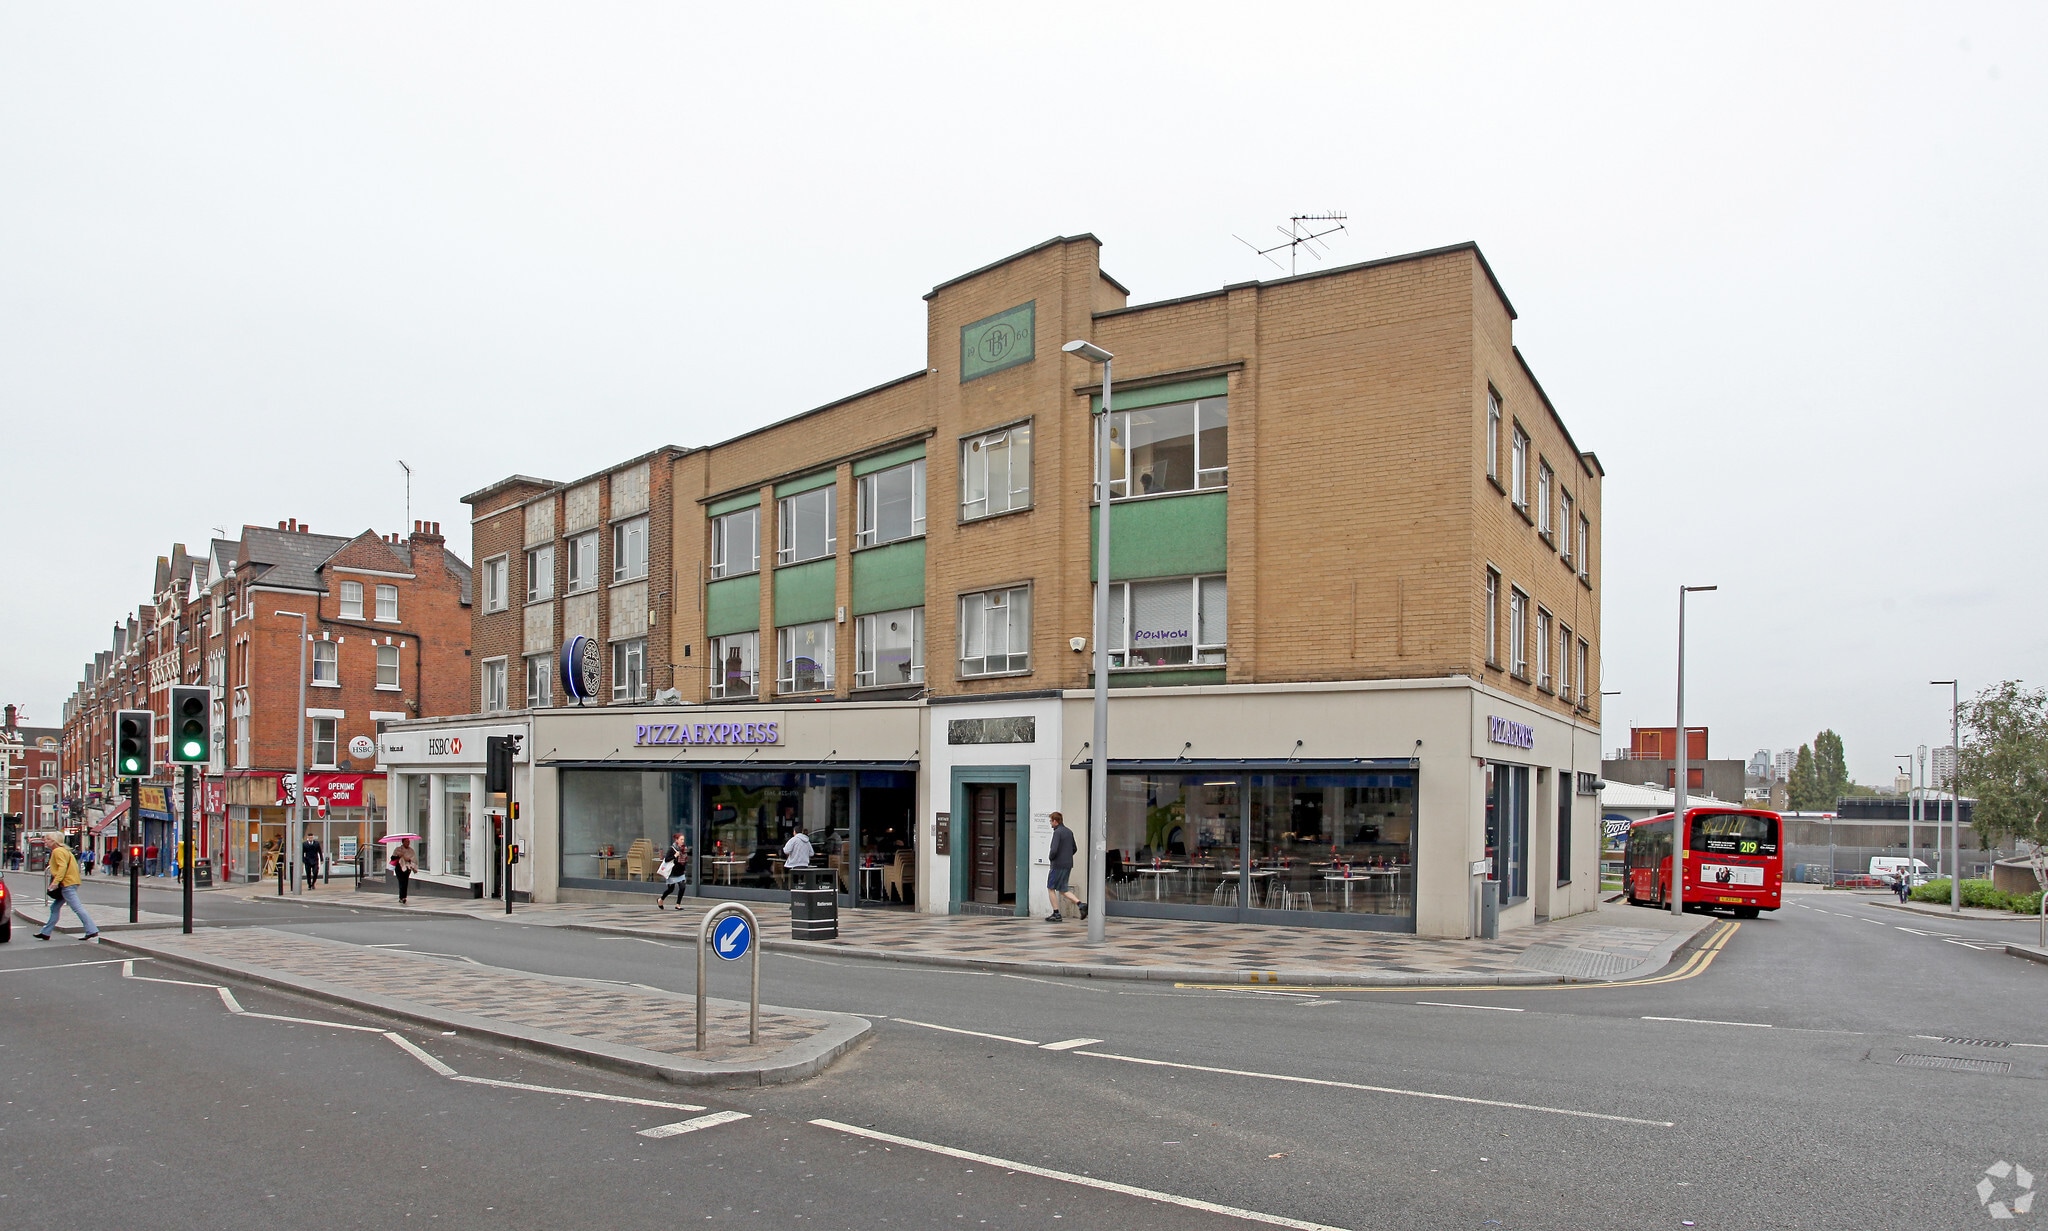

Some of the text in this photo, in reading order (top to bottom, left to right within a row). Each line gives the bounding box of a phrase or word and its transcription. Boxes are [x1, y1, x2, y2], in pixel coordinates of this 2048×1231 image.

[1016, 328, 1028, 341] 60
[636, 722, 778, 745] PIZZAEXPRESS
[1489, 715, 1534, 750] PIZZAEXPRESS
[429, 738, 450, 756] HSBC
[328, 782, 355, 791] OPENING
[332, 791, 350, 800] SOON
[1740, 841, 1757, 853] 219
